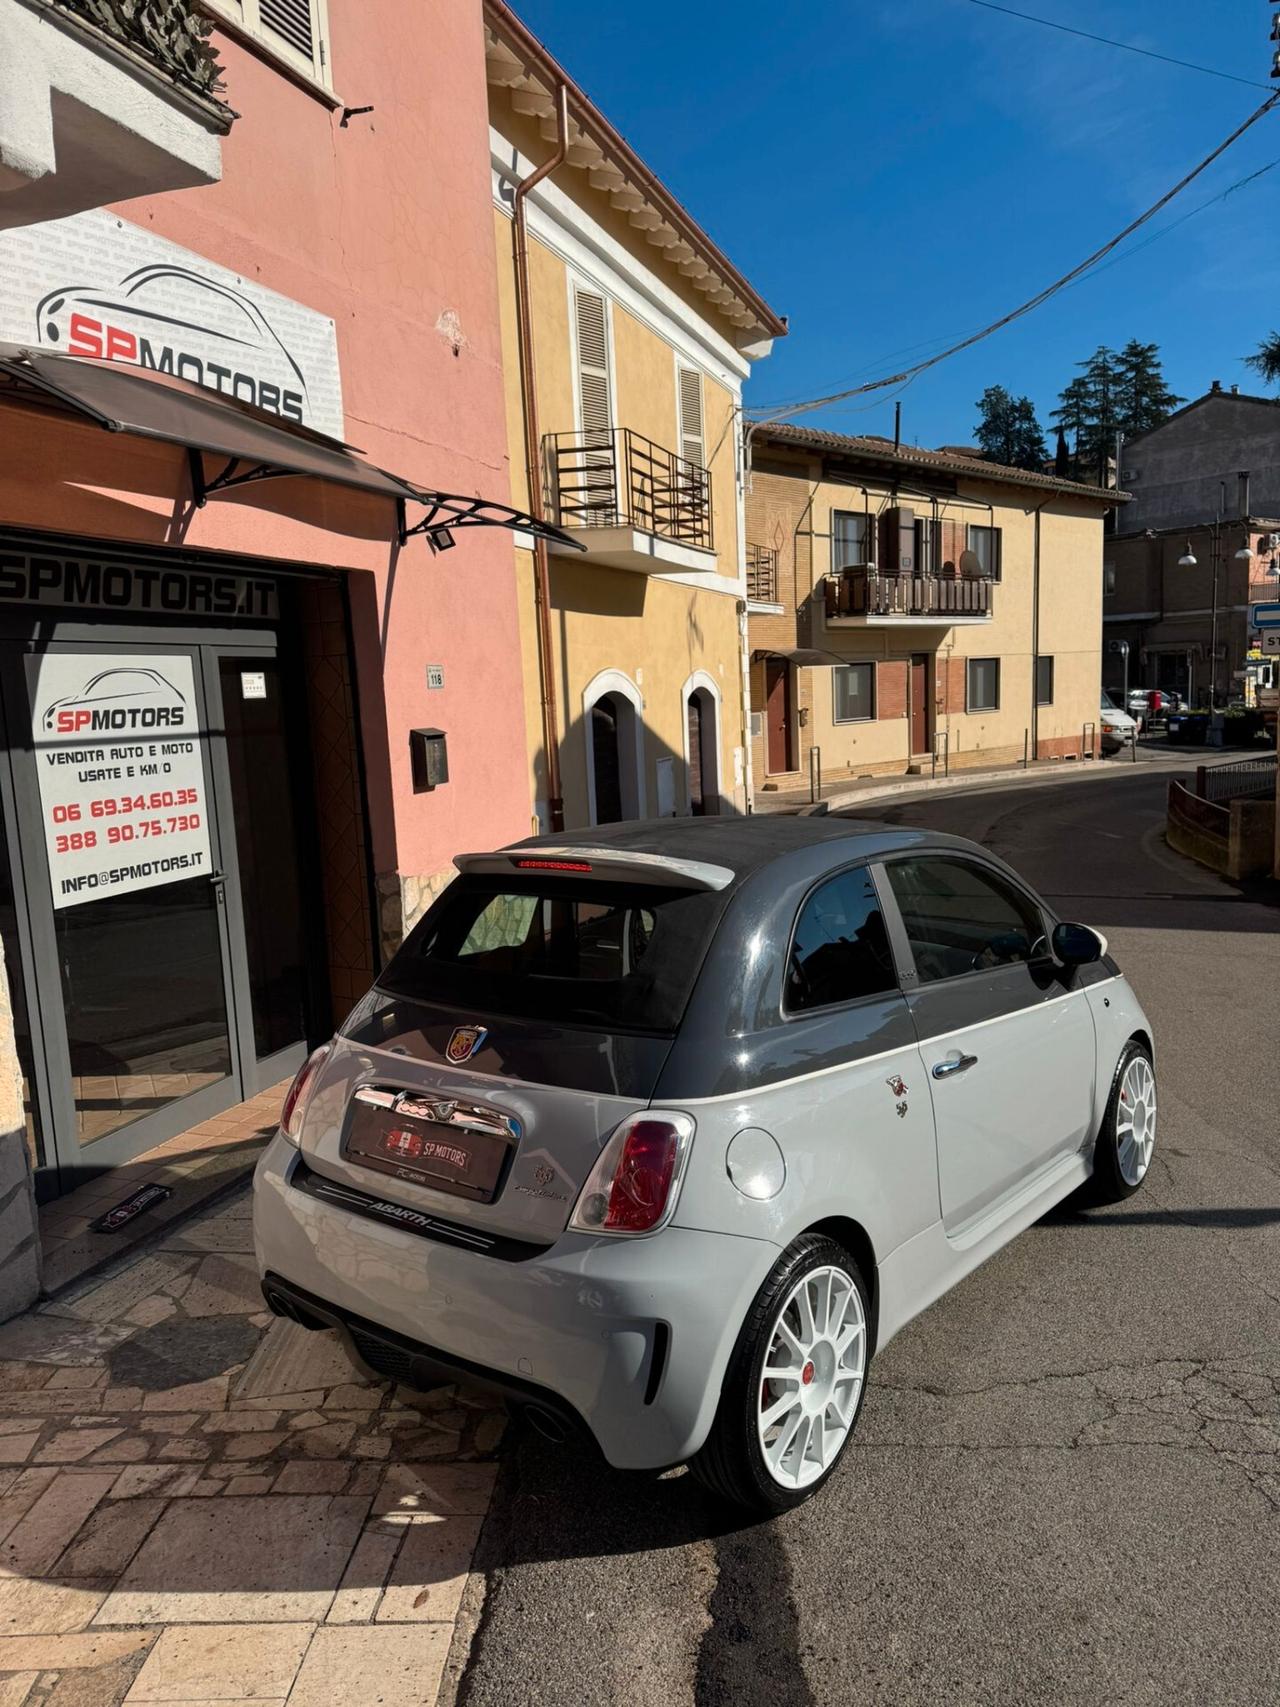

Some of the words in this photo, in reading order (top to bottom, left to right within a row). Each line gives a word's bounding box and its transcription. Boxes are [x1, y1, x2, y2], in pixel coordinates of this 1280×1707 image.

[69, 312, 303, 424] SPMOTORS
[0, 553, 275, 616] SPMOTORS.IT
[57, 706, 184, 733] SPMOTORS
[46, 748, 105, 766] VENDITA
[110, 746, 144, 760] AUTO
[149, 745, 157, 757] E
[161, 742, 194, 756] MOTO
[78, 768, 121, 783] USATE
[127, 766, 135, 778] E
[53, 804, 81, 823] 06
[91, 788, 198, 817] 69.34.60.35
[56, 831, 97, 853] 388
[107, 814, 200, 843] 90.75.730
[61, 852, 203, 894] INFO@SPMOTORS.IT
[434, 1145, 466, 1167] MOTORS
[370, 1202, 432, 1226] ABARTH
